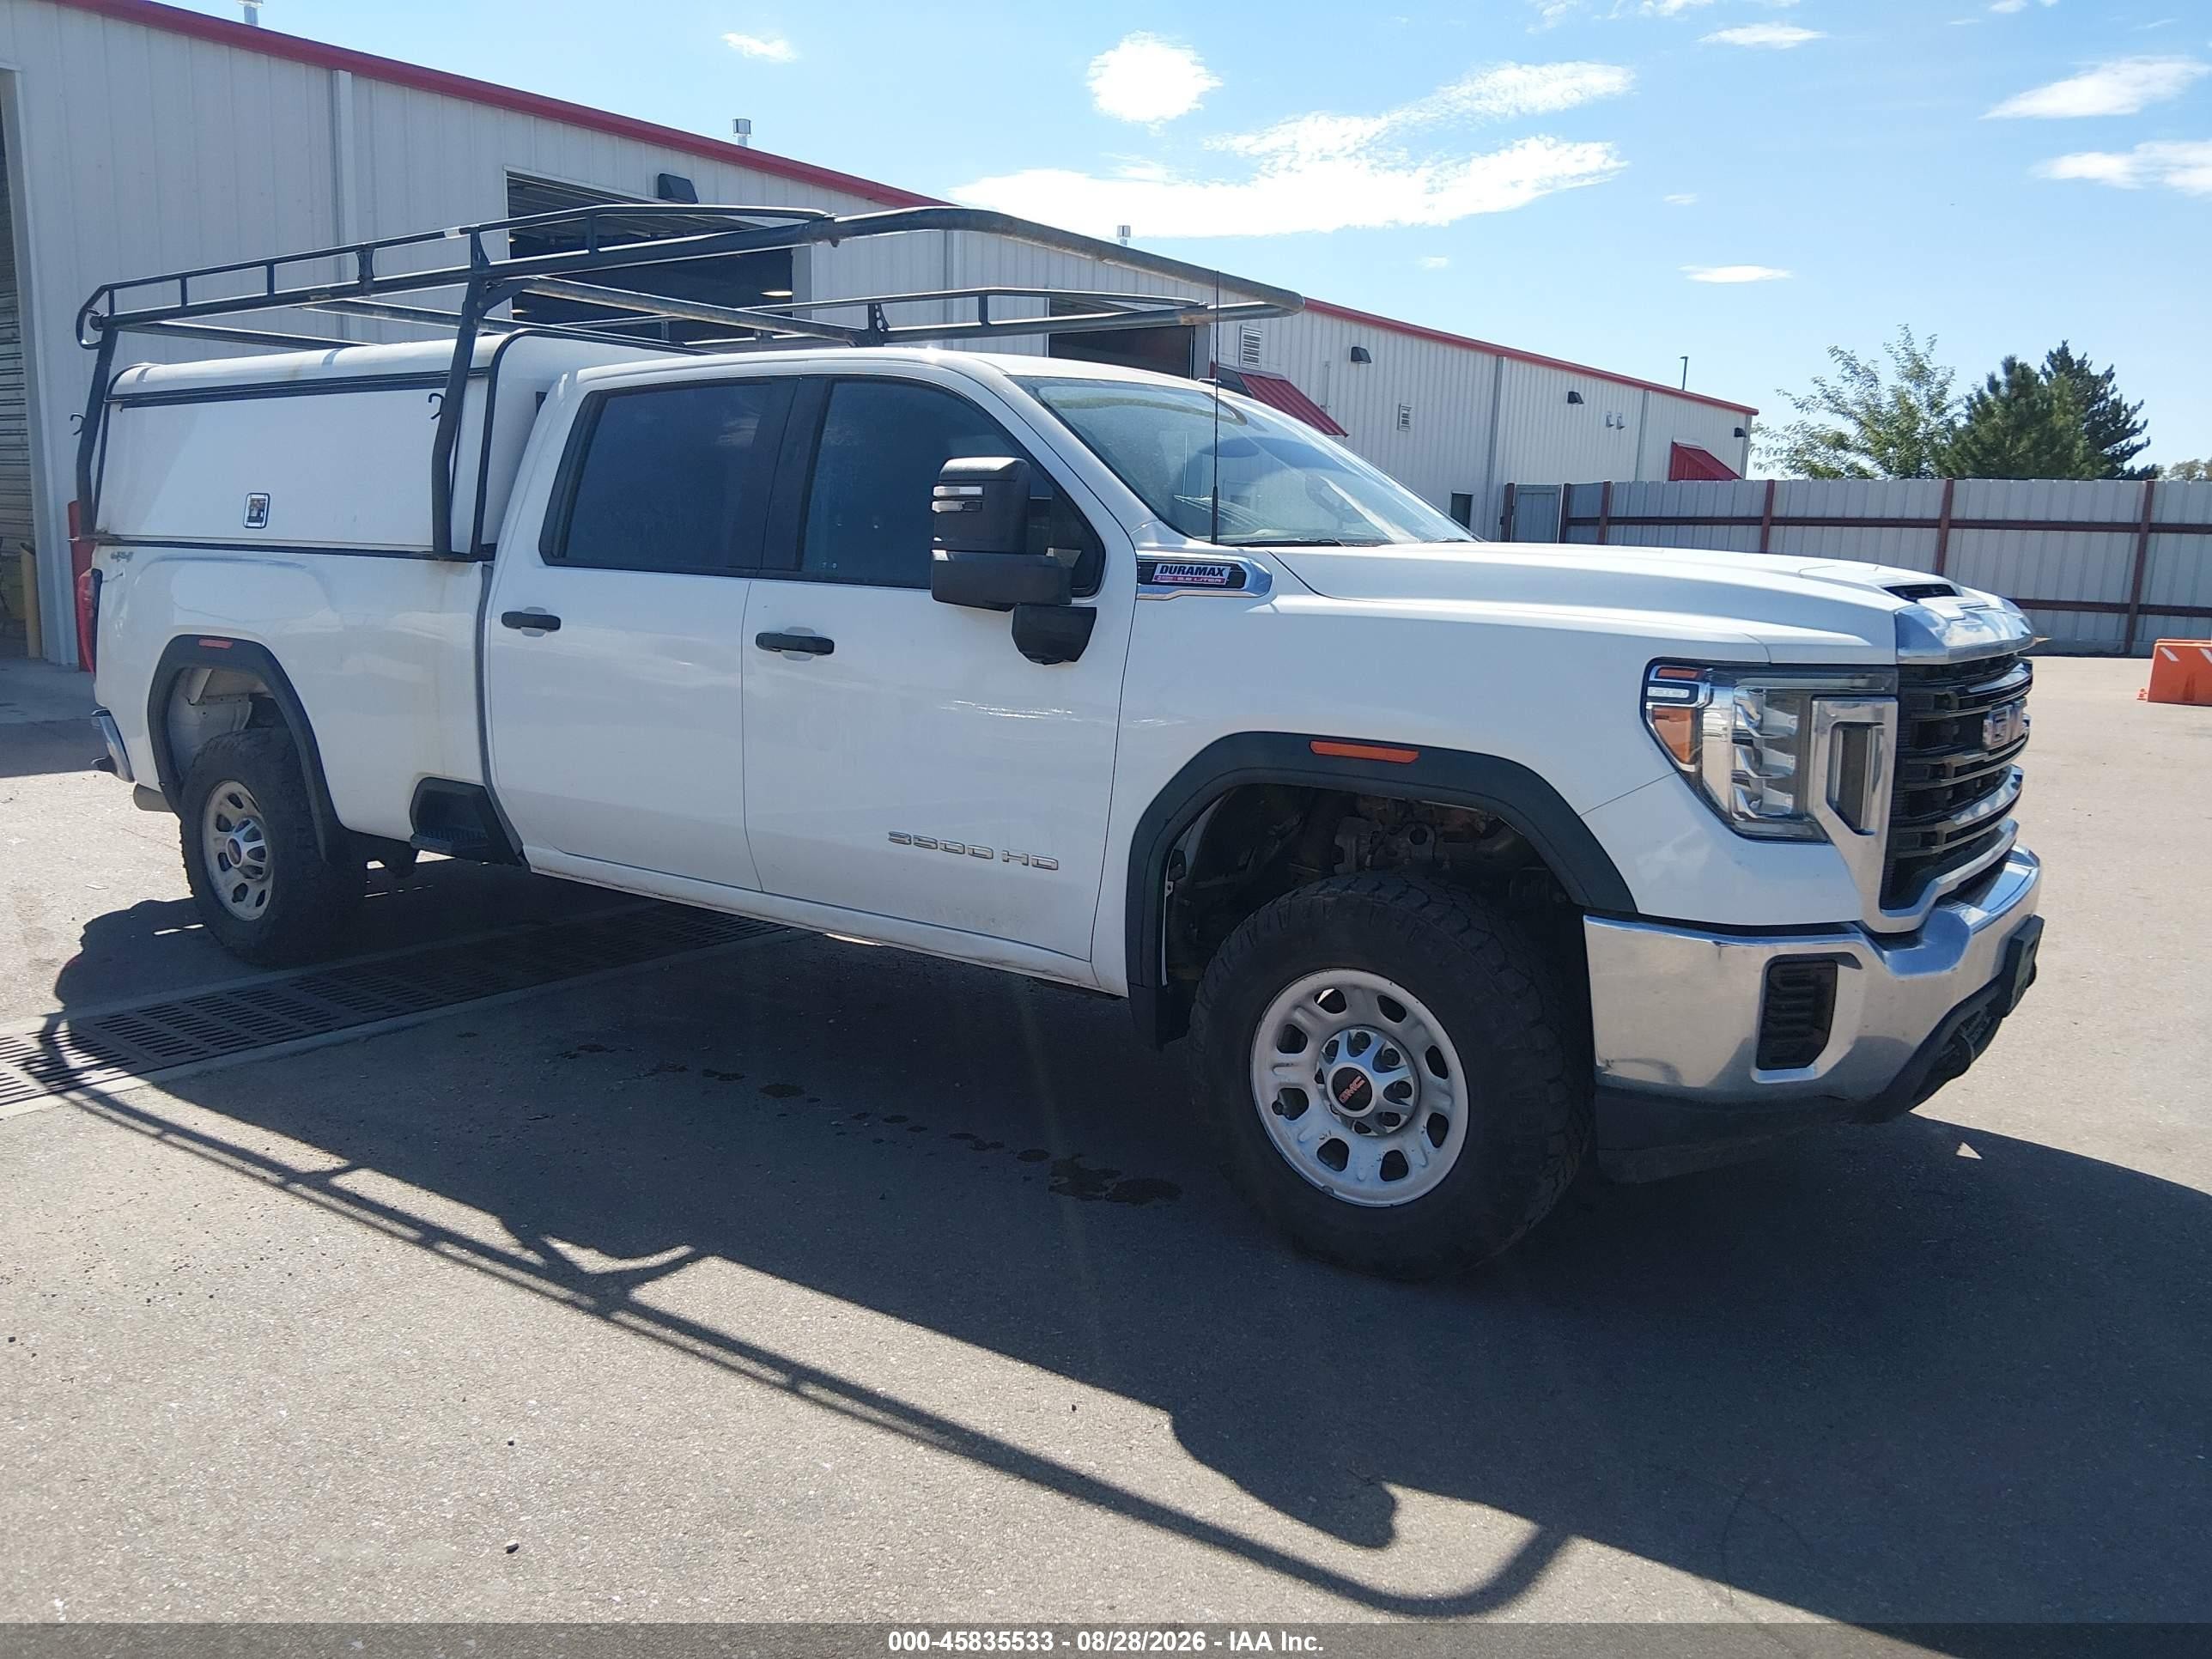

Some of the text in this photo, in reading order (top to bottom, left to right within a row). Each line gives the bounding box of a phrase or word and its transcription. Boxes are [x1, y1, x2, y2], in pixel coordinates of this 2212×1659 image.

[1159, 564, 1226, 577] DURAMAX
[888, 831, 1059, 871] 3500 HD
[1339, 1075, 1366, 1103] GMC
